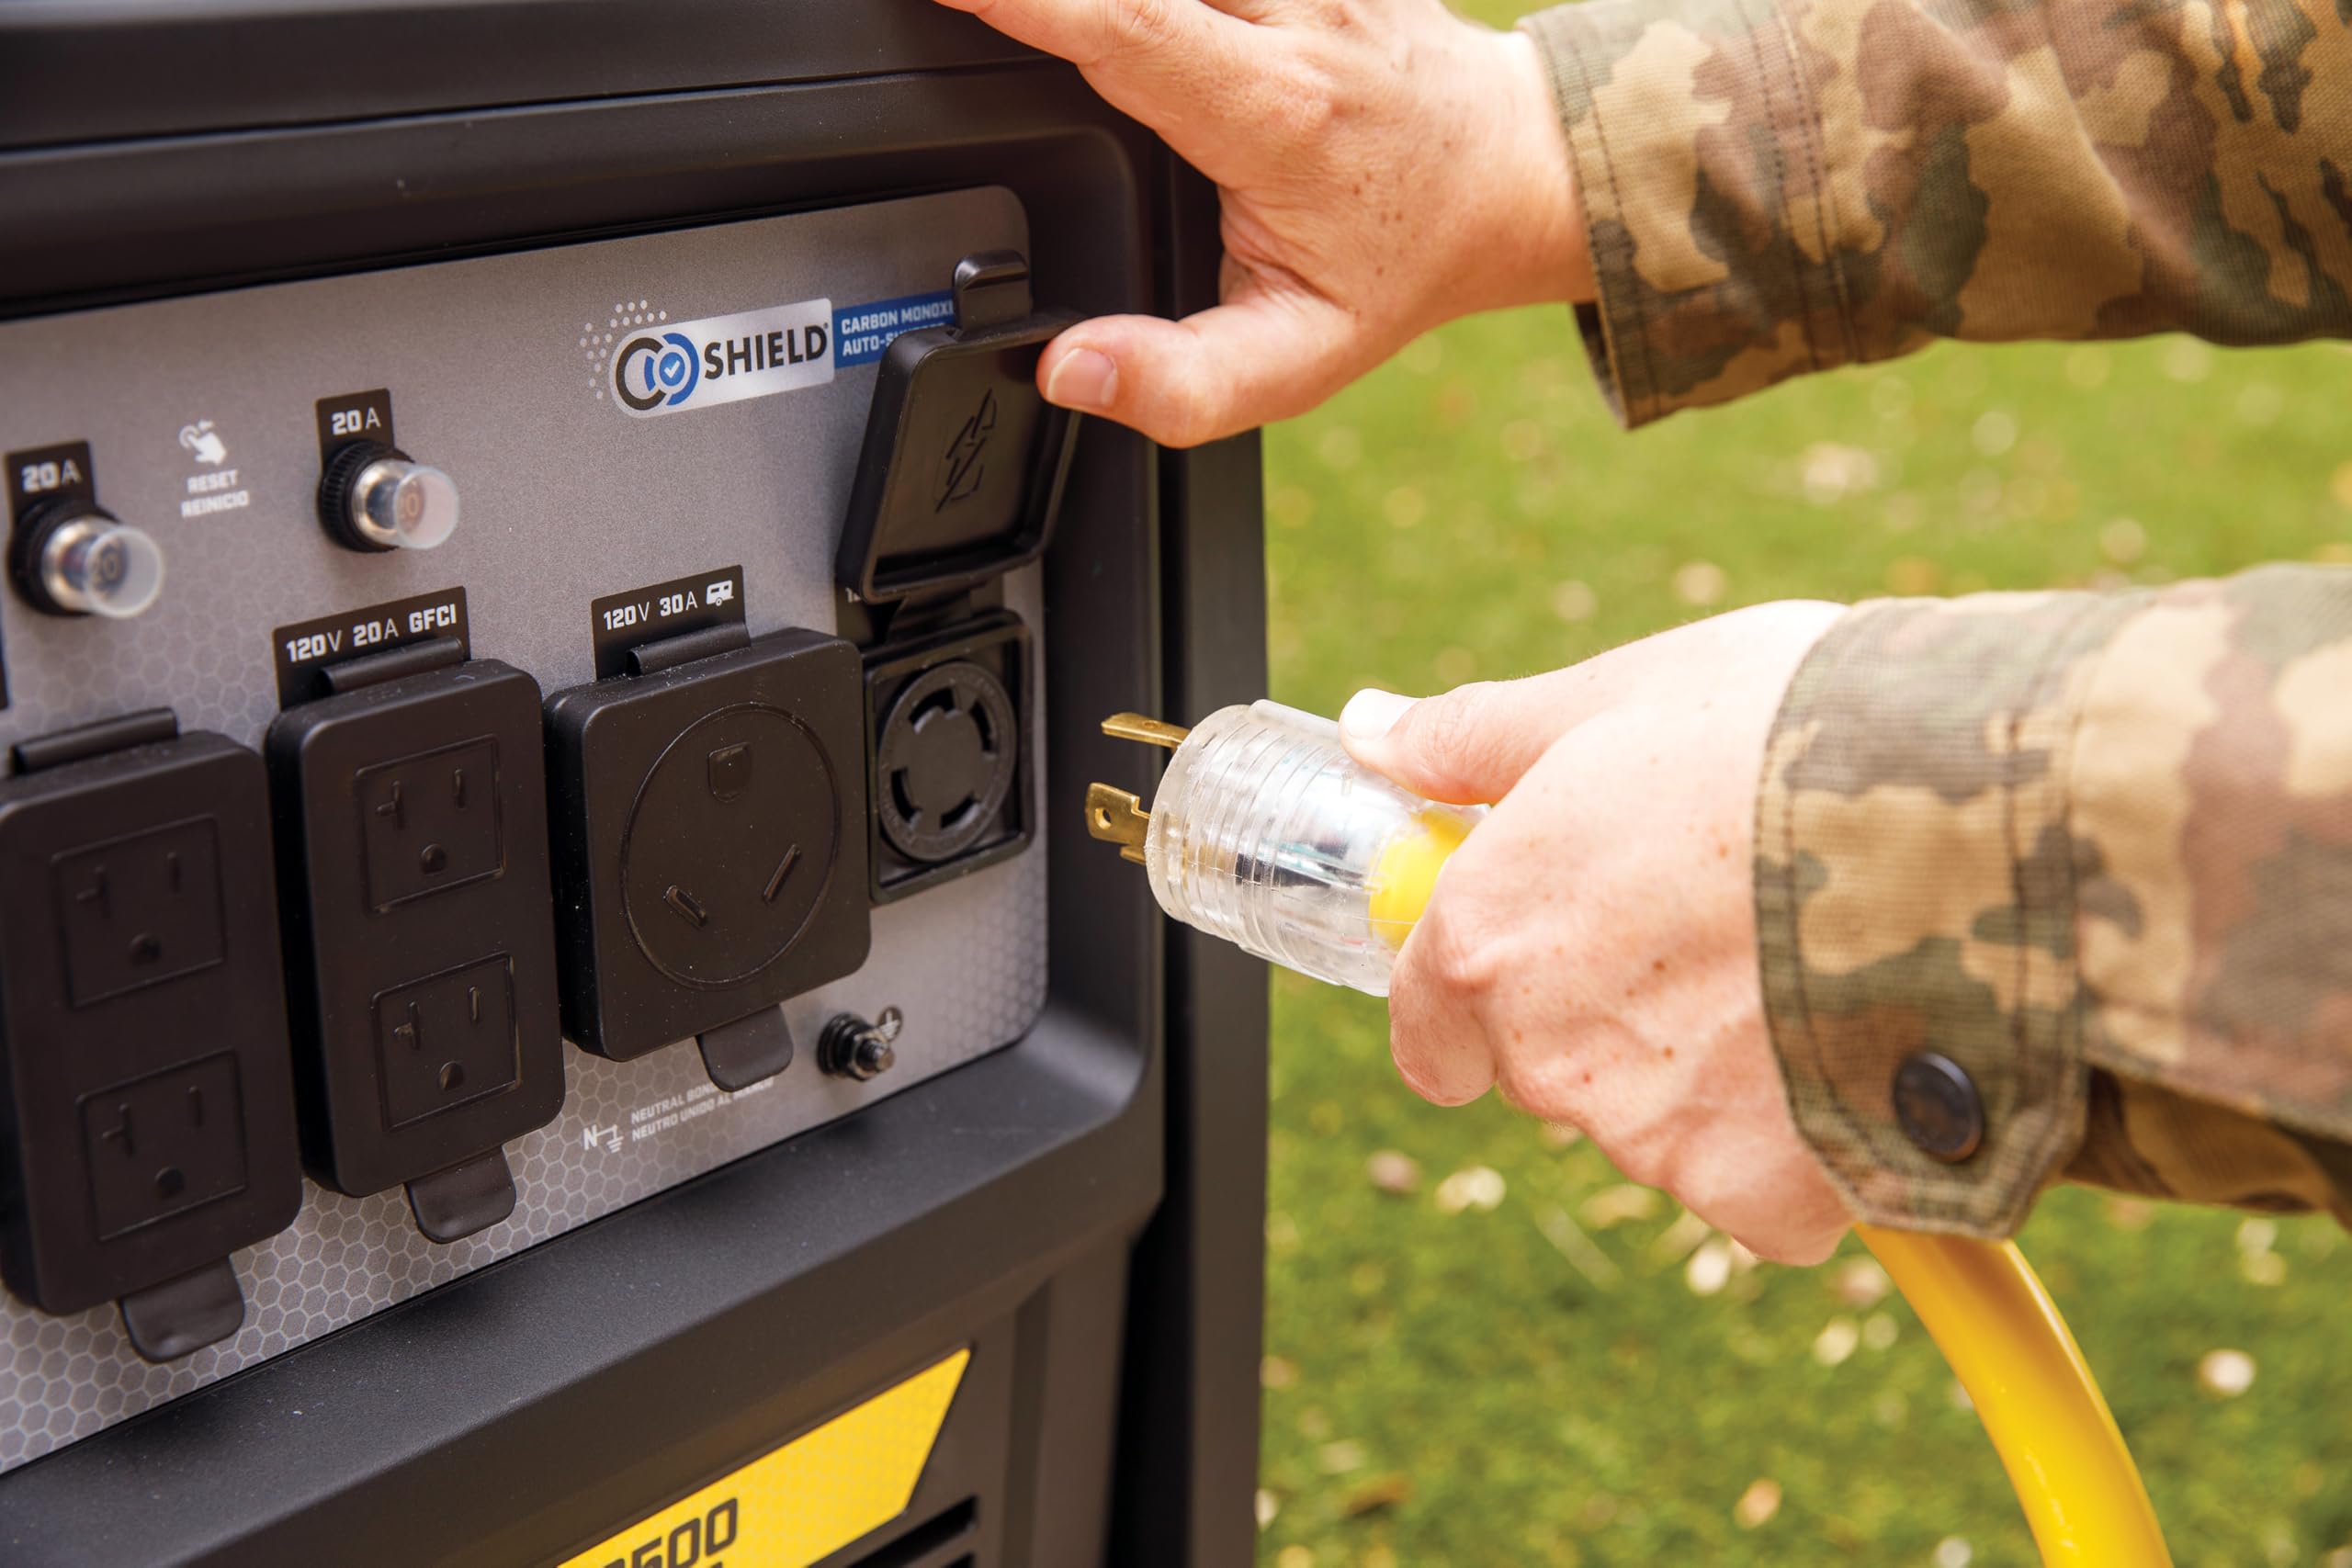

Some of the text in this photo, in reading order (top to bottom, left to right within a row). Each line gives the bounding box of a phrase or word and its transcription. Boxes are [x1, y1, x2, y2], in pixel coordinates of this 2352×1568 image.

[841, 299, 955, 335] CARBON MONOXI
[704, 324, 828, 380] SHIELD
[842, 331, 904, 356] AUTO-S
[187, 468, 239, 493] RESET
[180, 491, 250, 517] REINICIO
[603, 591, 698, 631] 120V 30A
[286, 603, 458, 662] 120V 20A GFCI
[631, 1094, 685, 1124] NEUTRAL
[631, 1112, 679, 1142] NEUTRO
[680, 1098, 716, 1122] UNIDO
[603, 1496, 738, 1568] 500
